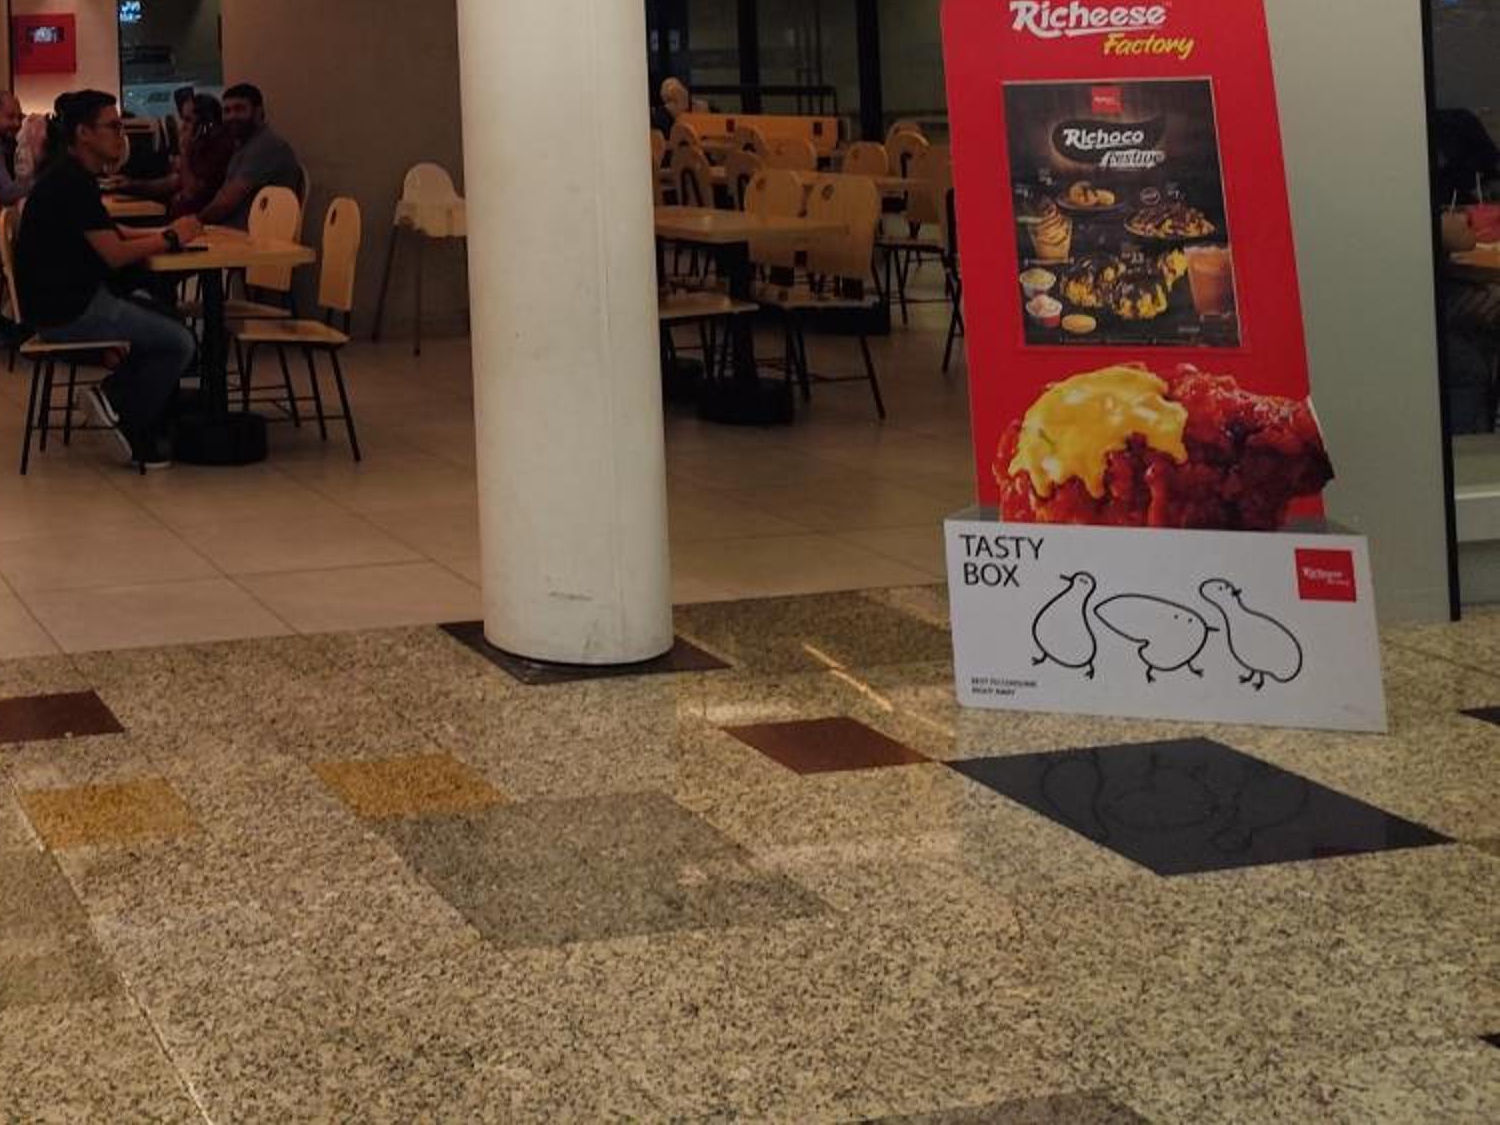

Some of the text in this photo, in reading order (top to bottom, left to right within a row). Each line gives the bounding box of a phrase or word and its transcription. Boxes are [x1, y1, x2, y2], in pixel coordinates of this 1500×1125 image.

[1009, 0, 1167, 38] Richeese
[1104, 32, 1195, 60] Factory
[959, 534, 1044, 561] TASTY
[963, 562, 1020, 587] BOX
